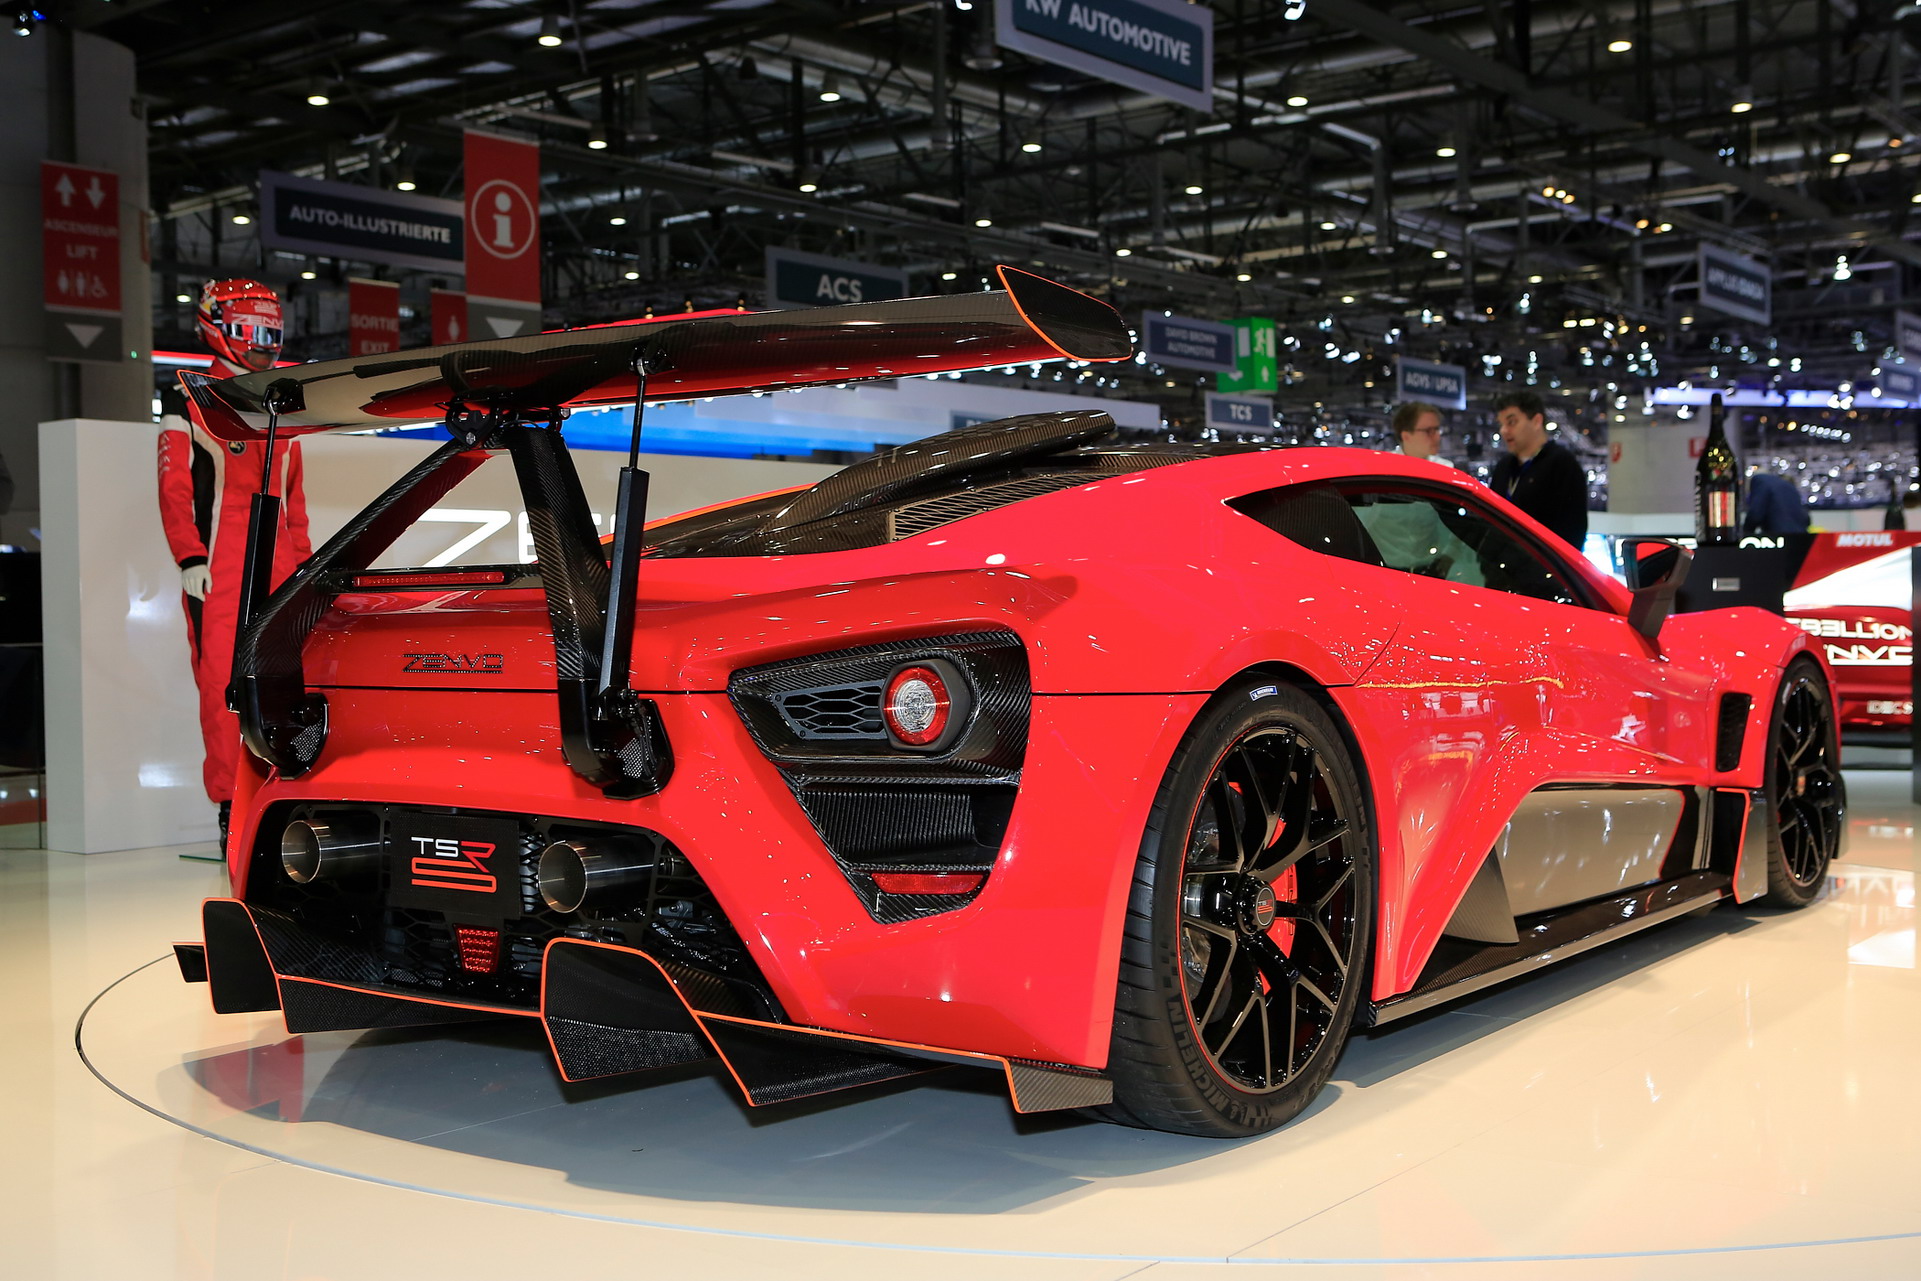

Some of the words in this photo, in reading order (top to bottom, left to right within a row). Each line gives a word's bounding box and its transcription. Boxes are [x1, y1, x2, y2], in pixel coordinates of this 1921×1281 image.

[1068, 2, 1191, 66] AUTOMOTIVE
[289, 205, 451, 244] AUTO-ILLUSTRIERTE
[66, 243, 98, 260] LIFT
[816, 274, 863, 302] ACS
[351, 313, 399, 333] SORTIE
[360, 340, 390, 355] EXIT
[1230, 404, 1252, 421] TCS
[1836, 534, 1892, 547] MOTUL
[402, 653, 503, 674] ZENVO
[411, 836, 496, 873] TSR
[1167, 1000, 1231, 1112] MICHELIN
